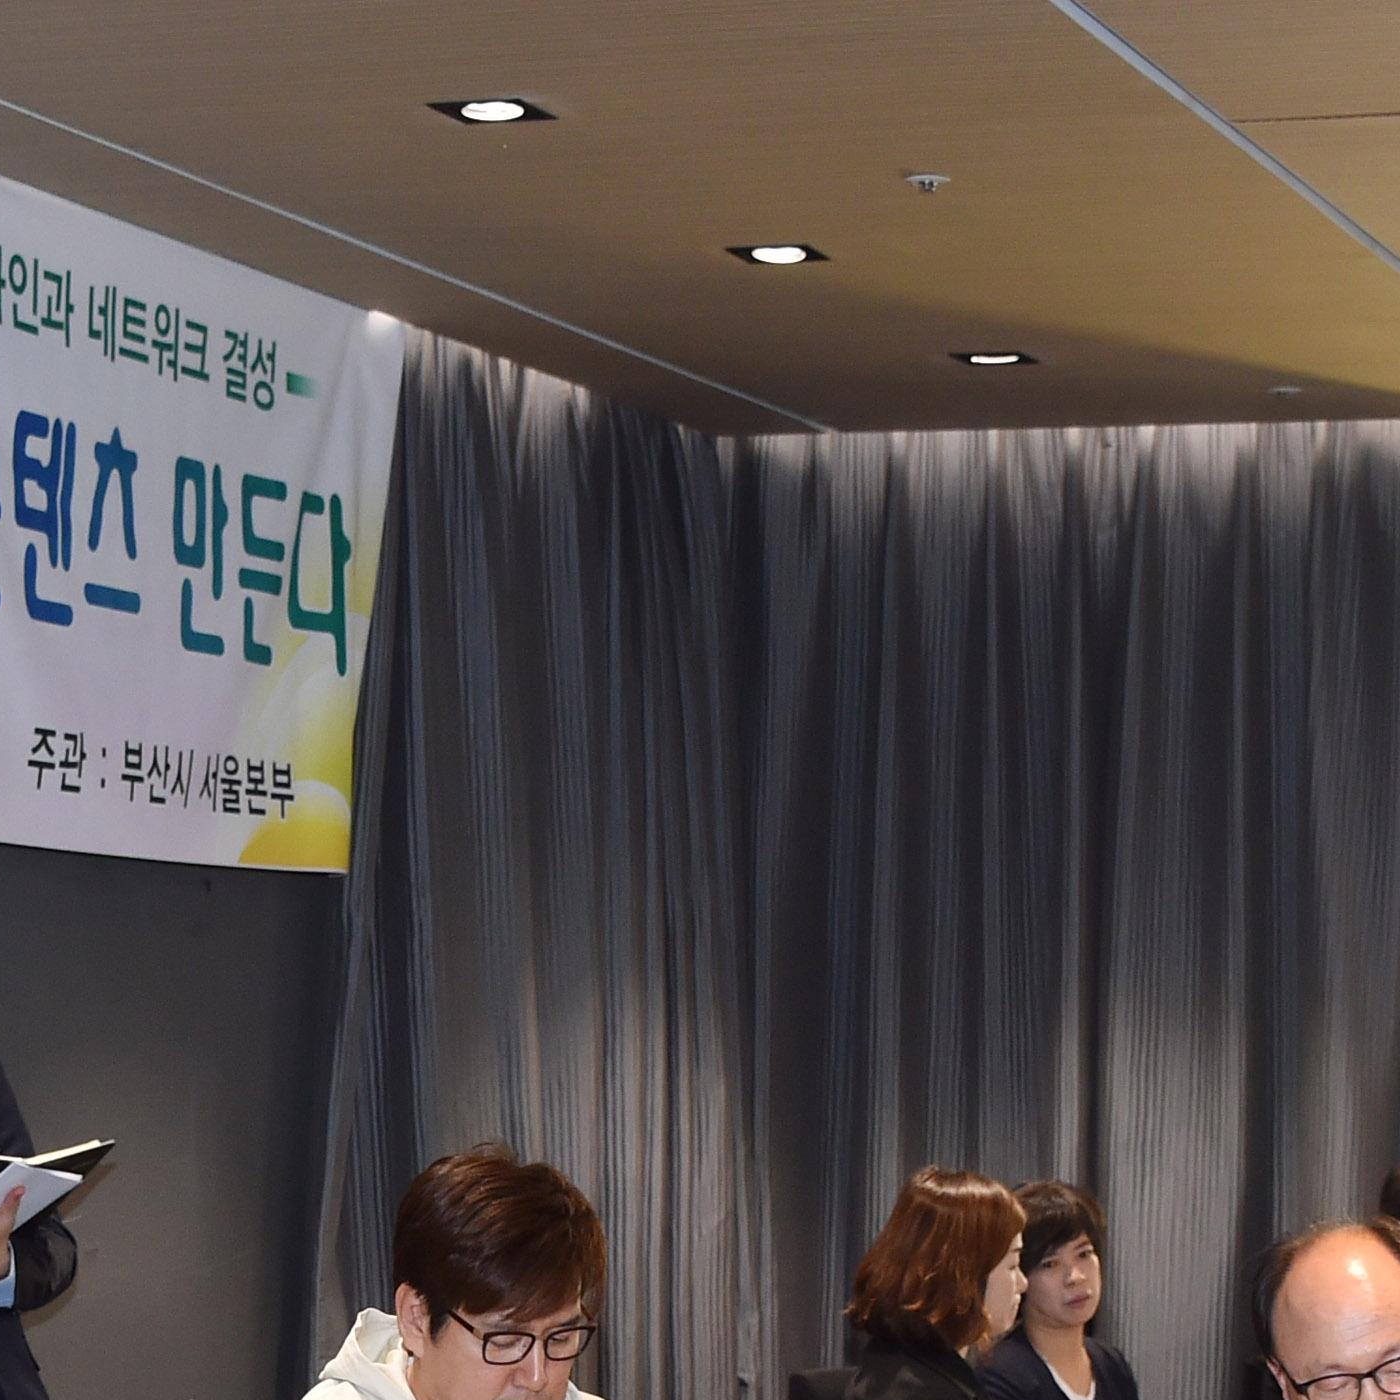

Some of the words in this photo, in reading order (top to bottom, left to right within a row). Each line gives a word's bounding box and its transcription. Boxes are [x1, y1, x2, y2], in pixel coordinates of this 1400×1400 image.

[88, 285, 210, 383] 네트워크
[222, 329, 277, 411] 결성
[173, 455, 352, 677] 만든다
[27, 727, 87, 794] 주관
[120, 740, 195, 809] 부산시
[199, 753, 295, 820] 서울본부
